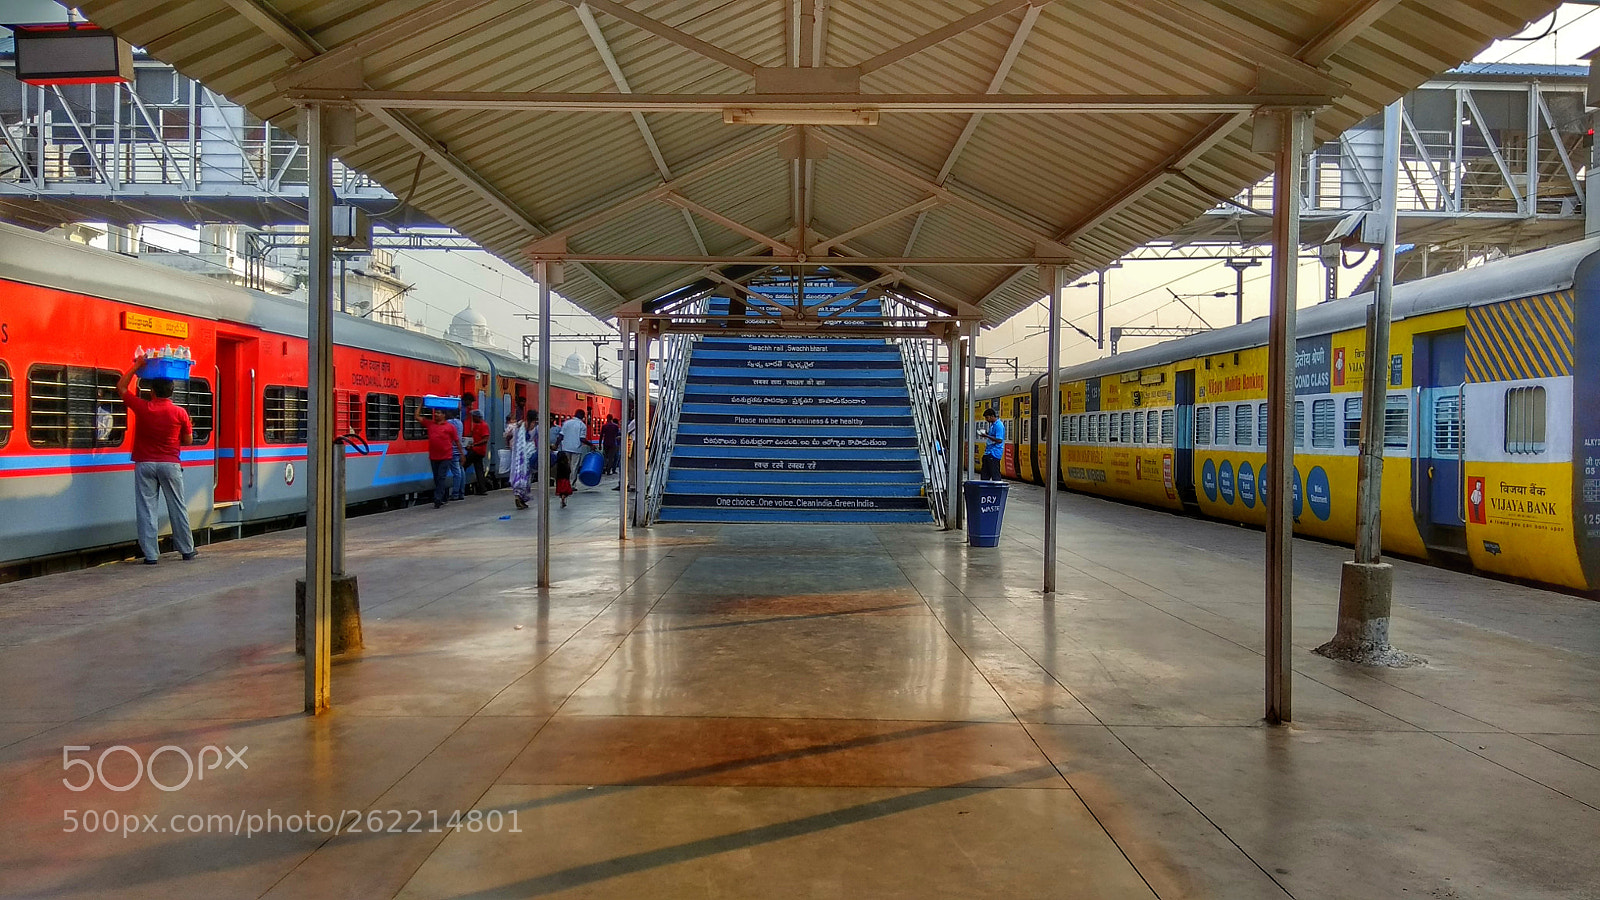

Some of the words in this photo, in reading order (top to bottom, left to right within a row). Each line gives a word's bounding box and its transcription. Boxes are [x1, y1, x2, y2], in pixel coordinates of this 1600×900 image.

[1225, 376, 1240, 392] Mobile
[1243, 372, 1264, 391] Banking
[1295, 373, 1310, 388] COND
[1310, 372, 1329, 387] CLASS
[1585, 467, 1596, 475] GS
[1500, 481, 1527, 495] विजया
[1529, 483, 1547, 496] बैंक
[716, 497, 731, 506] One
[981, 495, 997, 504] DRY
[1491, 498, 1525, 513] VIJAYA
[1527, 501, 1556, 515] BANK
